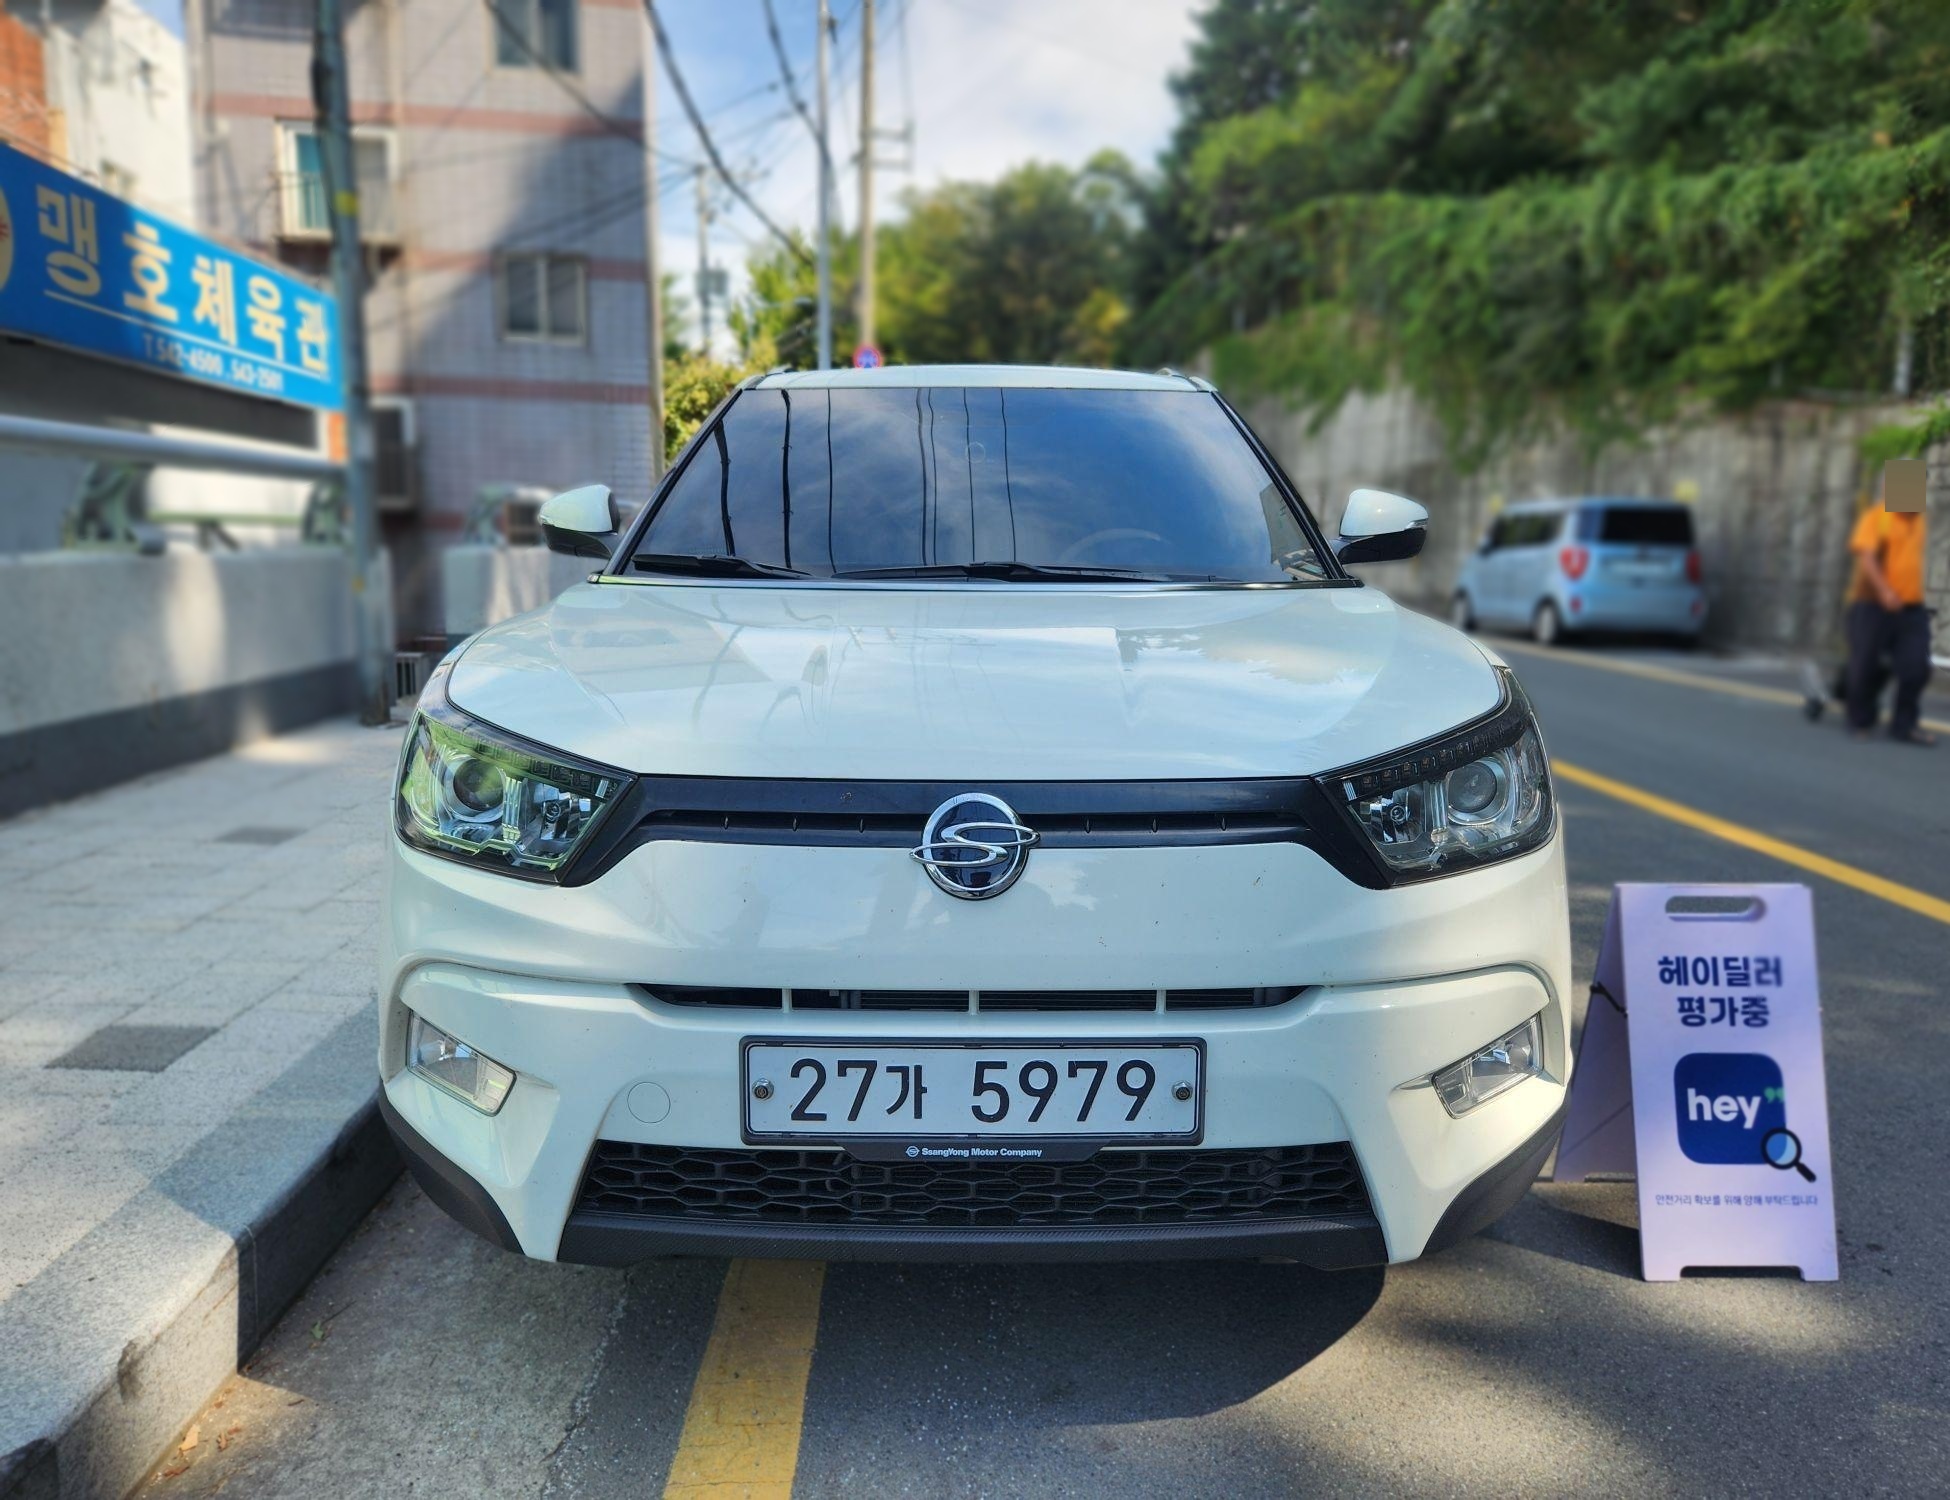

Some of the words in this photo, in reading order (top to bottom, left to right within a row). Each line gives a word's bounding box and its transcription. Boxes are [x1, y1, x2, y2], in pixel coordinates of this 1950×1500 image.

[36, 183, 331, 376] 맹호체육관
[1658, 956, 1783, 988] 헤이딜러
[1677, 996, 1769, 1028] 평가중
[789, 1058, 928, 1122] 27가
[971, 1059, 1156, 1123] 5979
[1687, 1087, 1762, 1130] hey
[921, 1147, 970, 1158] SsangYong
[971, 1147, 999, 1157] Motor
[1000, 1147, 1043, 1158] Company
[1655, 1194, 1692, 1206] 안전거리
[1694, 1194, 1721, 1206] 확보를
[1724, 1194, 1742, 1206] 위해
[1743, 1194, 1763, 1206] 양해
[1765, 1194, 1818, 1206] 부탁드립니다
